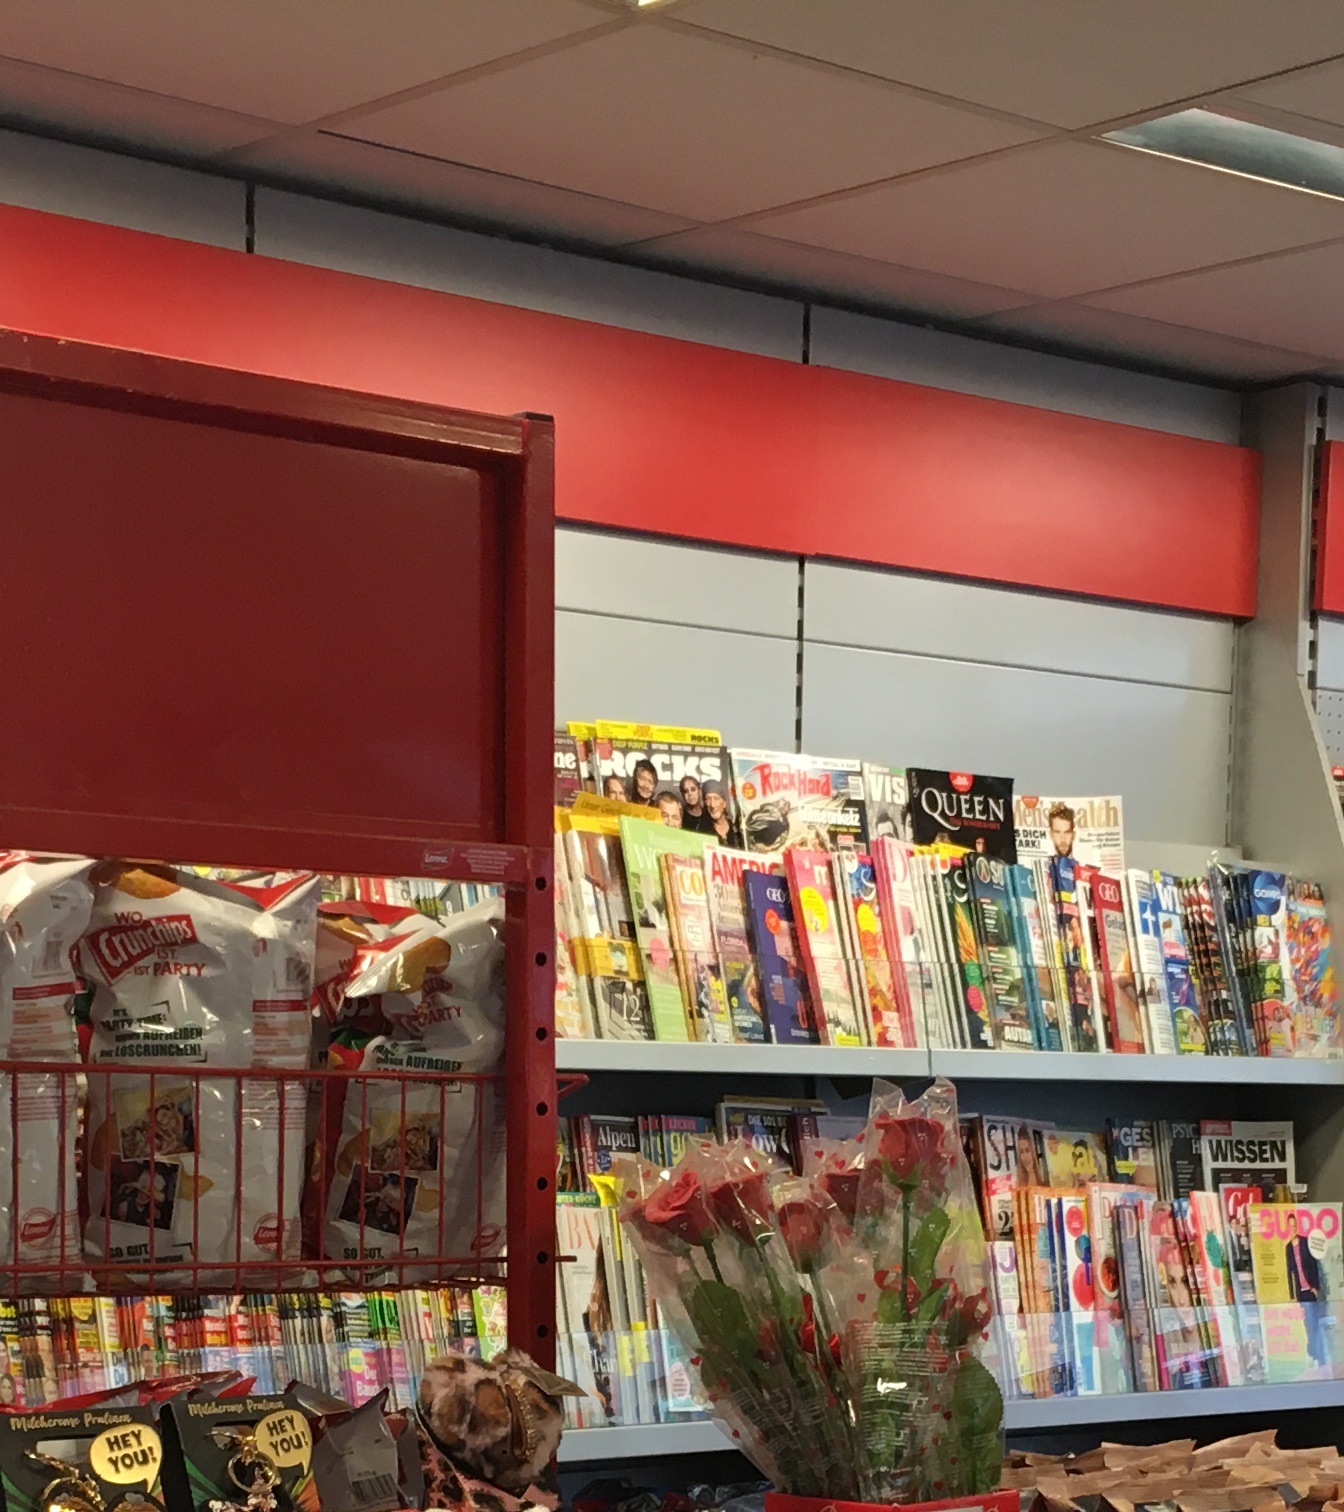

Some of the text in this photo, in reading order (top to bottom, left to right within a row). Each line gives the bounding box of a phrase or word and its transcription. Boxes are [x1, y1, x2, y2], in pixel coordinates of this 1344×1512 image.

[690, 733, 720, 745] ROCKS
[598, 750, 721, 783] ROCKS
[920, 787, 1005, 831] QUEEN
[1022, 829, 1047, 841] DICH
[100, 916, 196, 968] Crunchips
[153, 962, 205, 978] PARTY
[597, 1122, 636, 1152] Alpen
[1208, 1138, 1287, 1164] WISSEN
[1258, 1207, 1340, 1241] GUDO
[106, 1428, 143, 1452] HEY
[106, 1447, 157, 1473] YOU!
